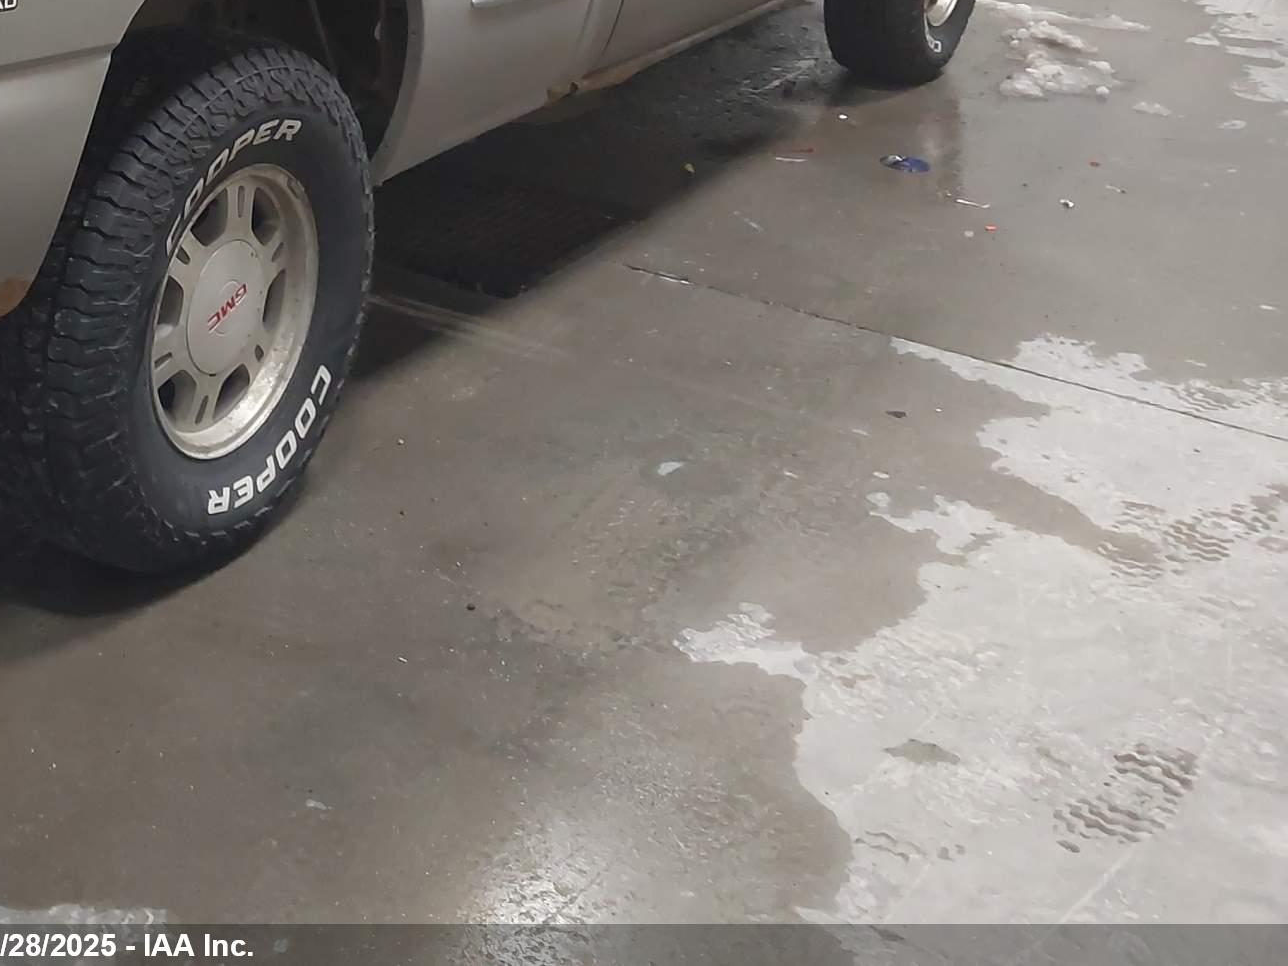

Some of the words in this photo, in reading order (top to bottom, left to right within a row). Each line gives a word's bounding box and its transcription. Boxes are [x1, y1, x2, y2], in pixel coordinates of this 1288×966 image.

[166, 119, 302, 256] COOPER
[207, 283, 248, 334] GMC
[207, 365, 332, 515] COOPER
